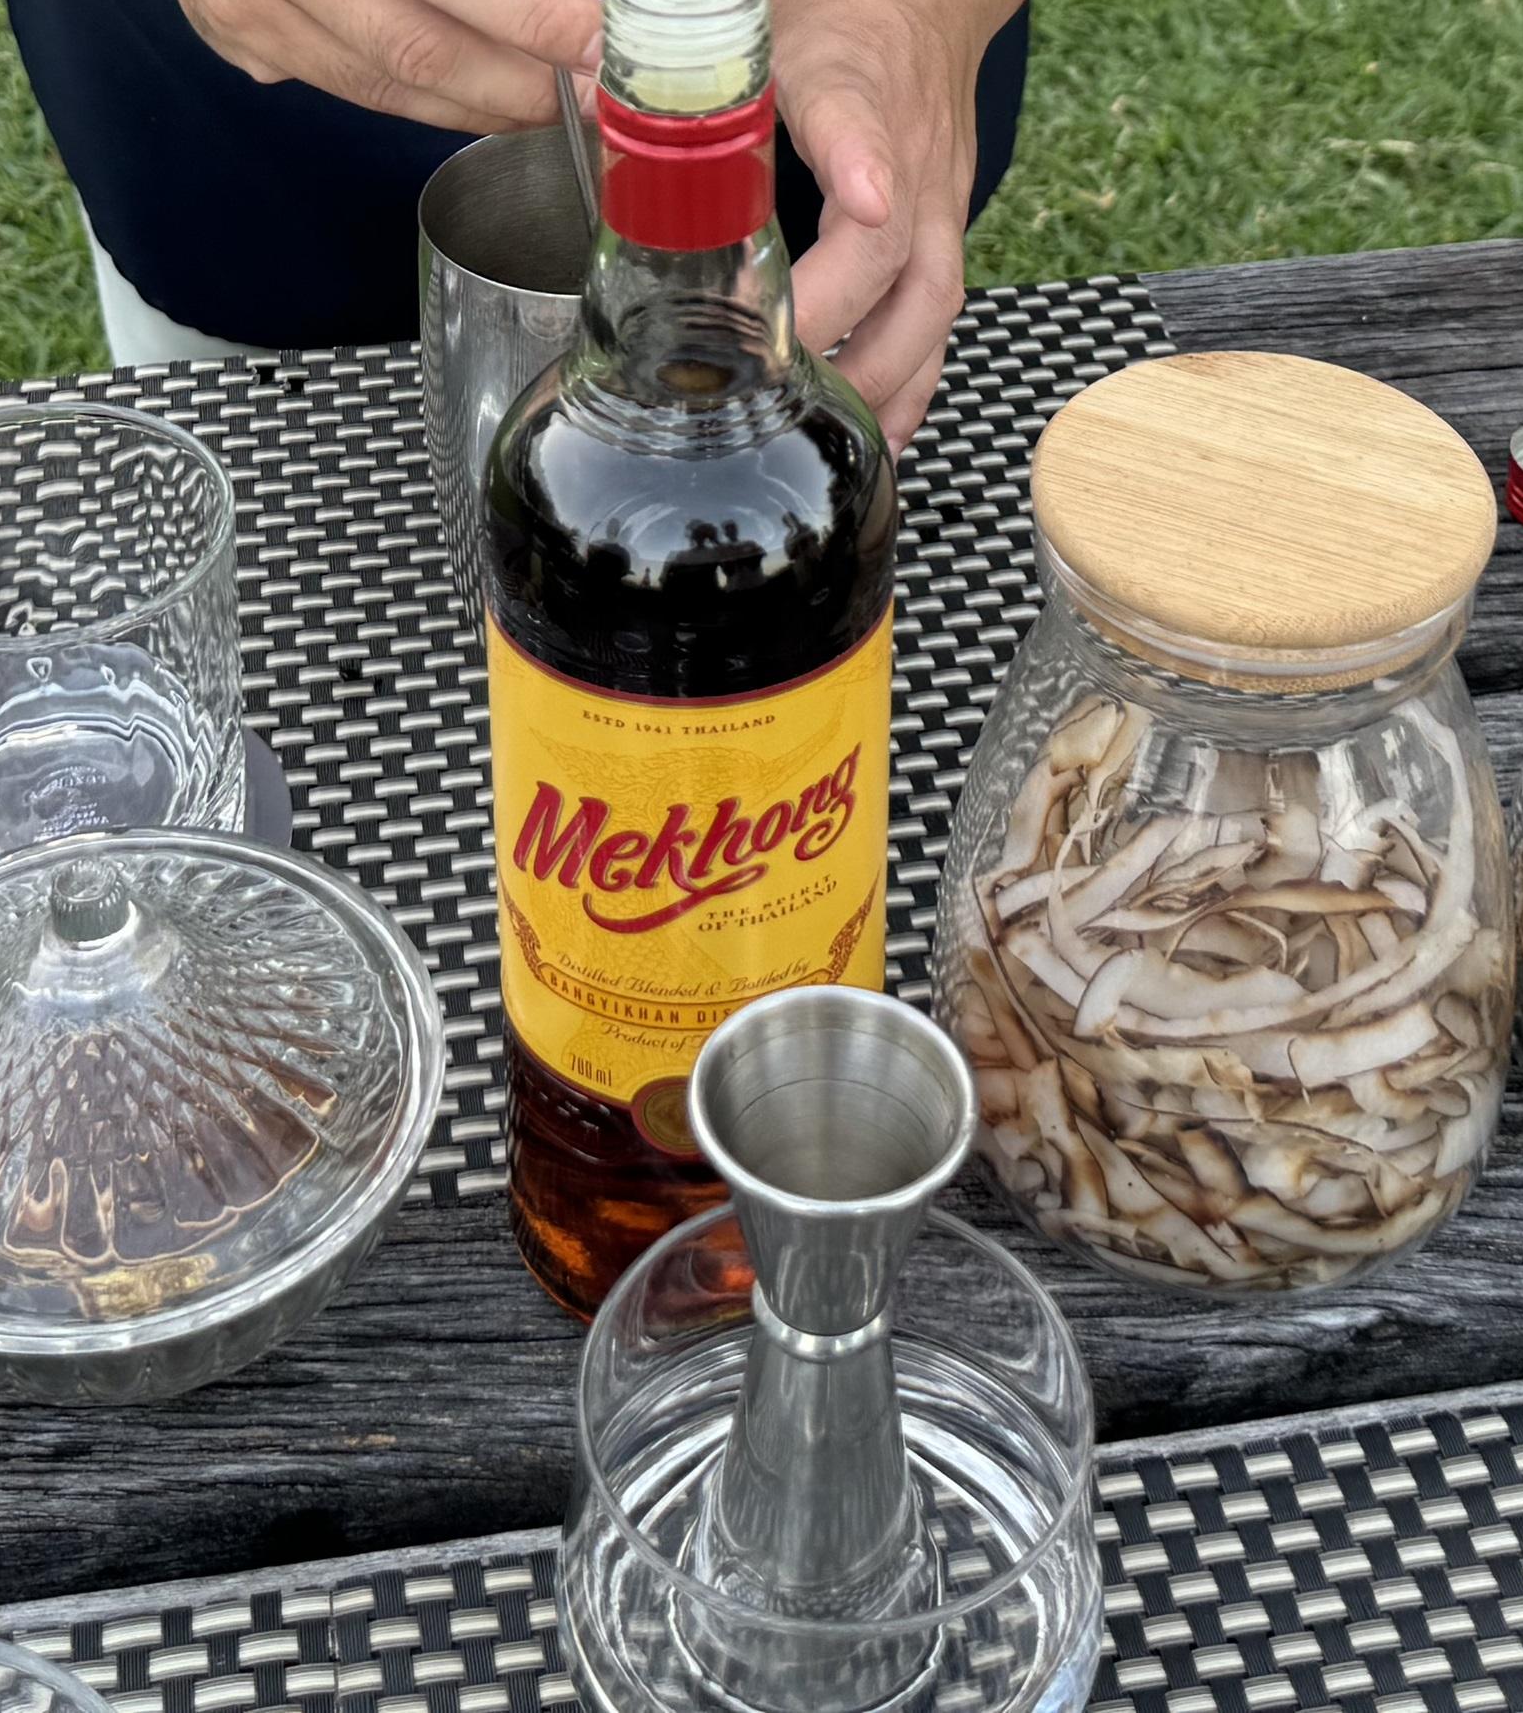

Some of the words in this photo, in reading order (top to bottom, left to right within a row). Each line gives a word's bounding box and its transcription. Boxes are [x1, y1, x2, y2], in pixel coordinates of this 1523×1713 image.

[582, 709, 626, 729] ESTD
[635, 722, 672, 735] 1941
[681, 714, 776, 735] THAILAND
[513, 741, 862, 934] Mekhong
[698, 920, 729, 932] OF
[733, 880, 837, 928] THAILAND
[706, 906, 750, 920] THE
[762, 874, 830, 911] SPIRIT
[550, 970, 680, 1025] BANGYIKHAN
[557, 951, 624, 988] Distilled
[624, 975, 701, 998] Blended
[726, 959, 793, 994] Bottled
[792, 956, 812, 977] by
[601, 1021, 668, 1049] Product
[669, 1036, 691, 1053] of
[569, 1053, 593, 1081] 700
[595, 1068, 613, 1087] ml
